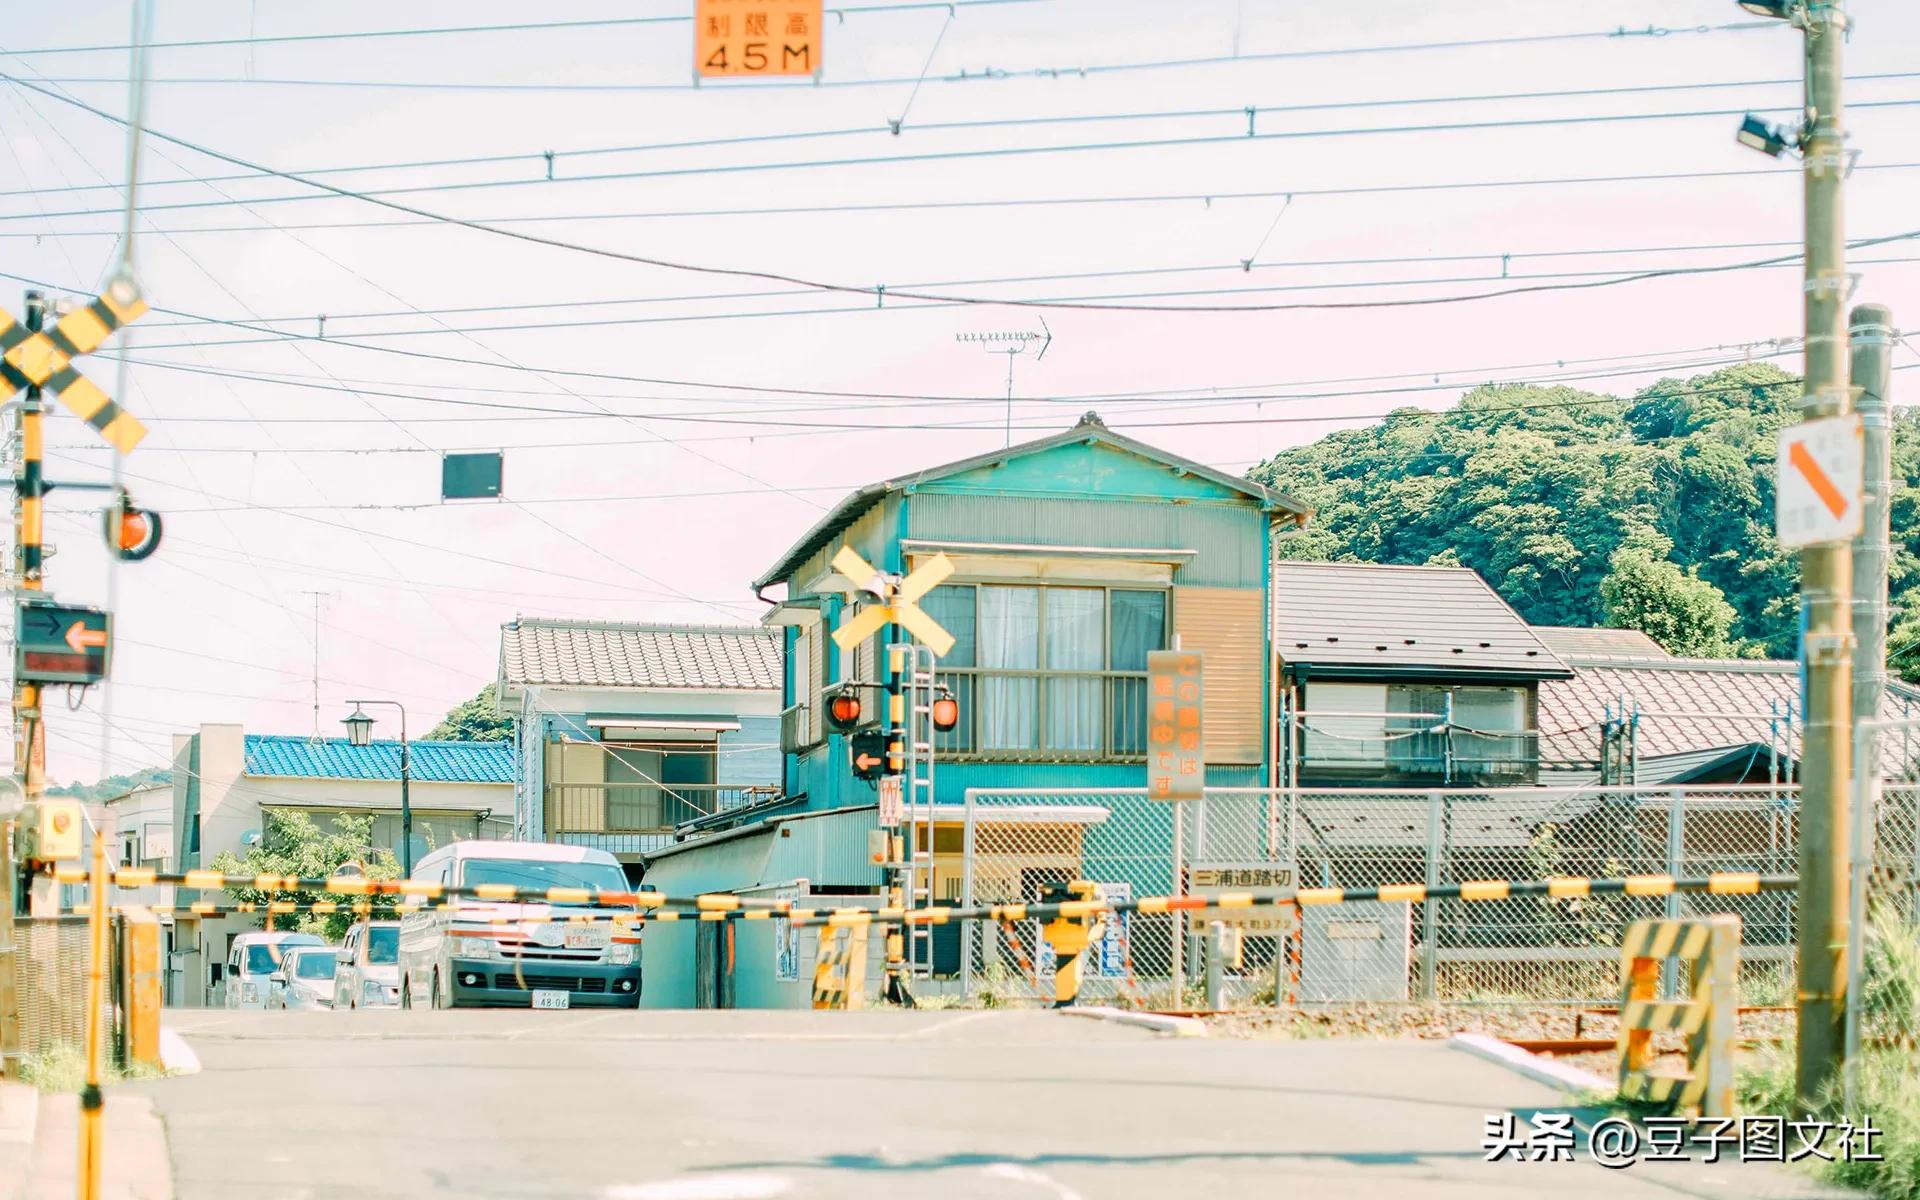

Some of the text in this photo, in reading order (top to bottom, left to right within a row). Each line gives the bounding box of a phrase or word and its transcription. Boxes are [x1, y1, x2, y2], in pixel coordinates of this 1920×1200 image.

[1177, 655, 1199, 776] このは
[1195, 868, 1292, 887] 三浦道踏切
